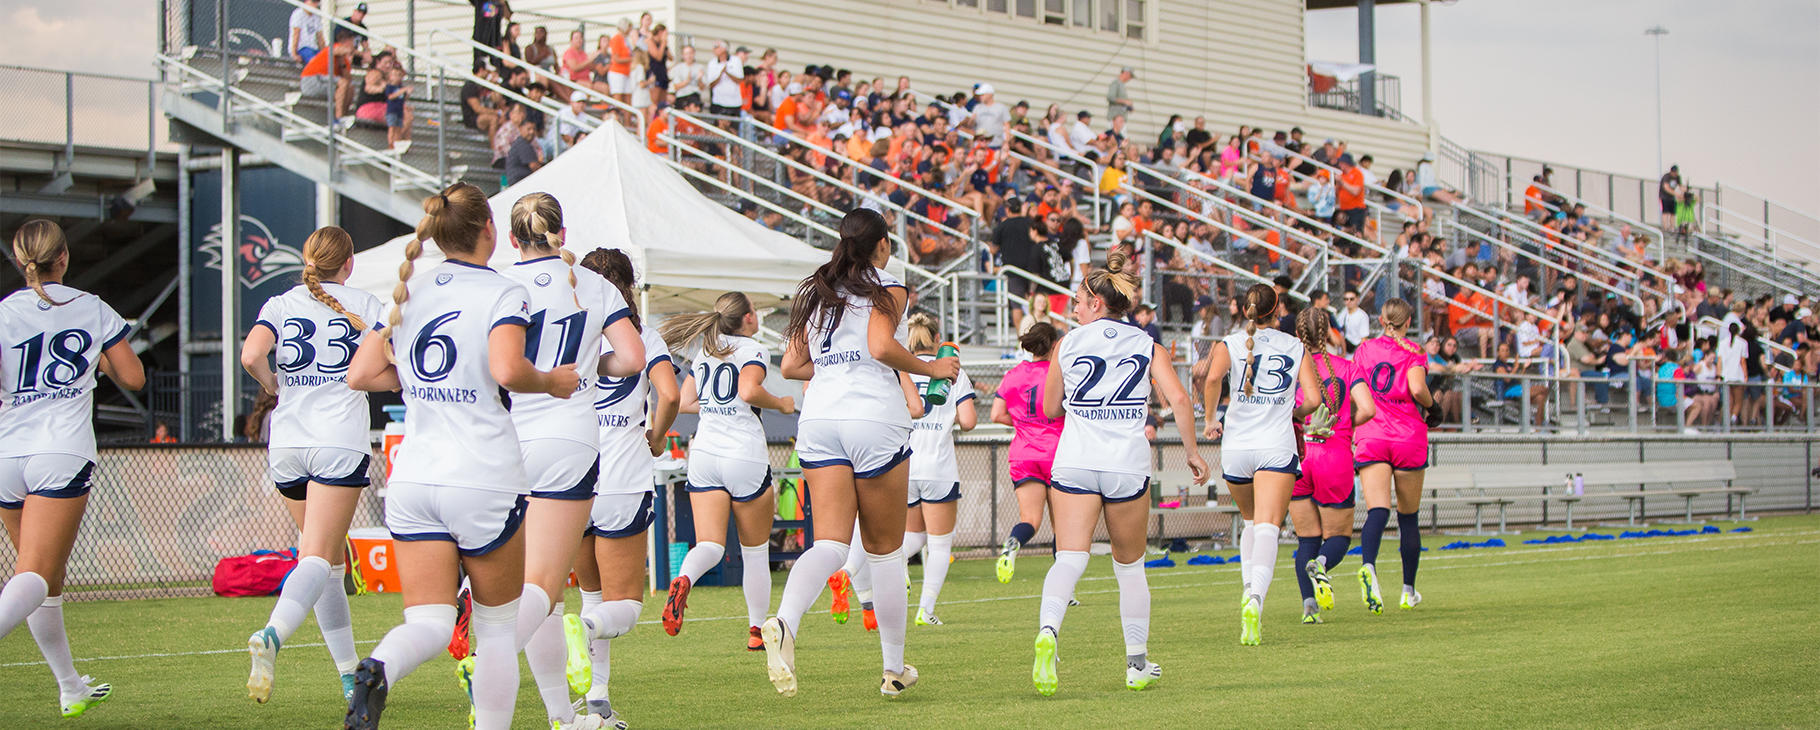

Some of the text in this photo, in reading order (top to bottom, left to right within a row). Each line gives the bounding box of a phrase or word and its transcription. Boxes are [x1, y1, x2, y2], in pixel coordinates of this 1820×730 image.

[10, 328, 93, 394] 18
[277, 317, 362, 374] 33
[410, 310, 462, 383] 6
[524, 308, 589, 368] 11
[697, 362, 740, 405] 20
[1069, 353, 1150, 407] 22
[1238, 353, 1295, 394] 13
[1369, 361, 1397, 396] 0
[1024, 383, 1039, 418] 1
[368, 545, 388, 571] G
